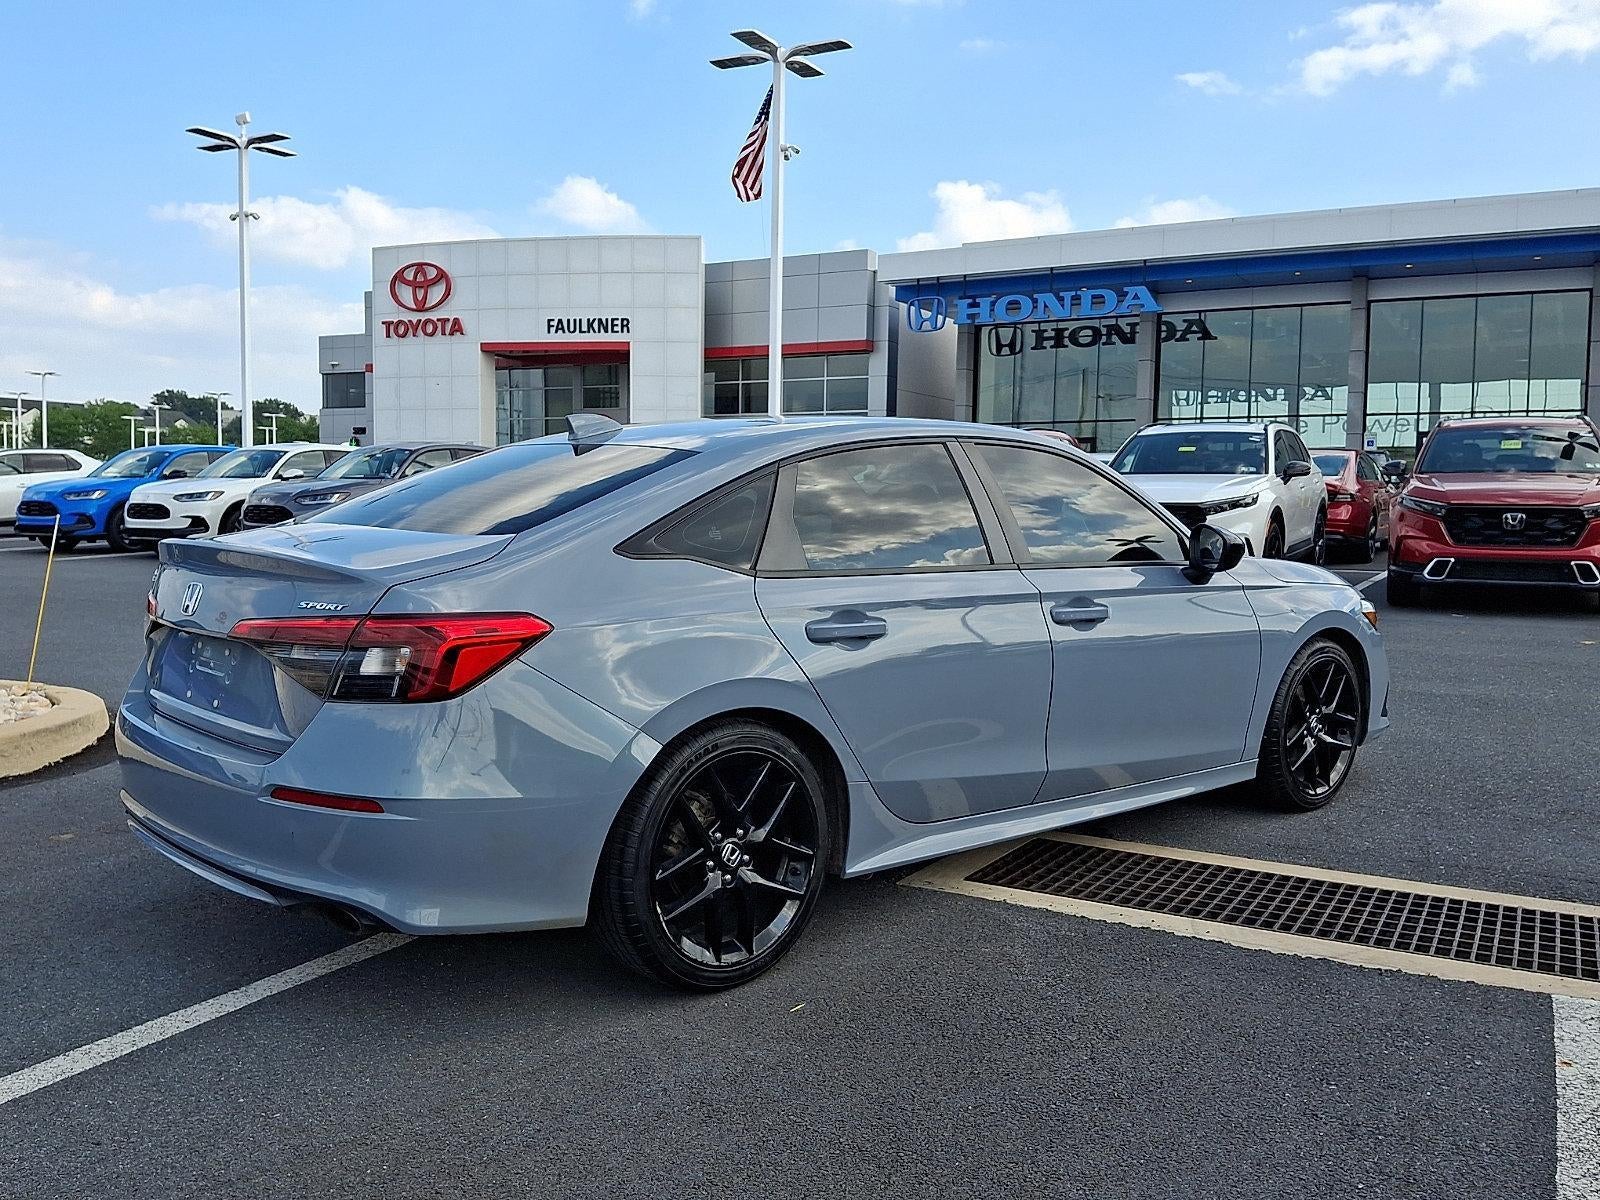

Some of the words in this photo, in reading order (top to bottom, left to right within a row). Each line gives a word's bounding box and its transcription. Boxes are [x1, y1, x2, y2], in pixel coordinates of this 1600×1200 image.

[953, 285, 1162, 325] HONDA
[382, 317, 465, 339] TOYOTA
[546, 317, 631, 335] FAULKNER
[1321, 415, 1424, 434] Pwer
[298, 600, 349, 611] SPORT
